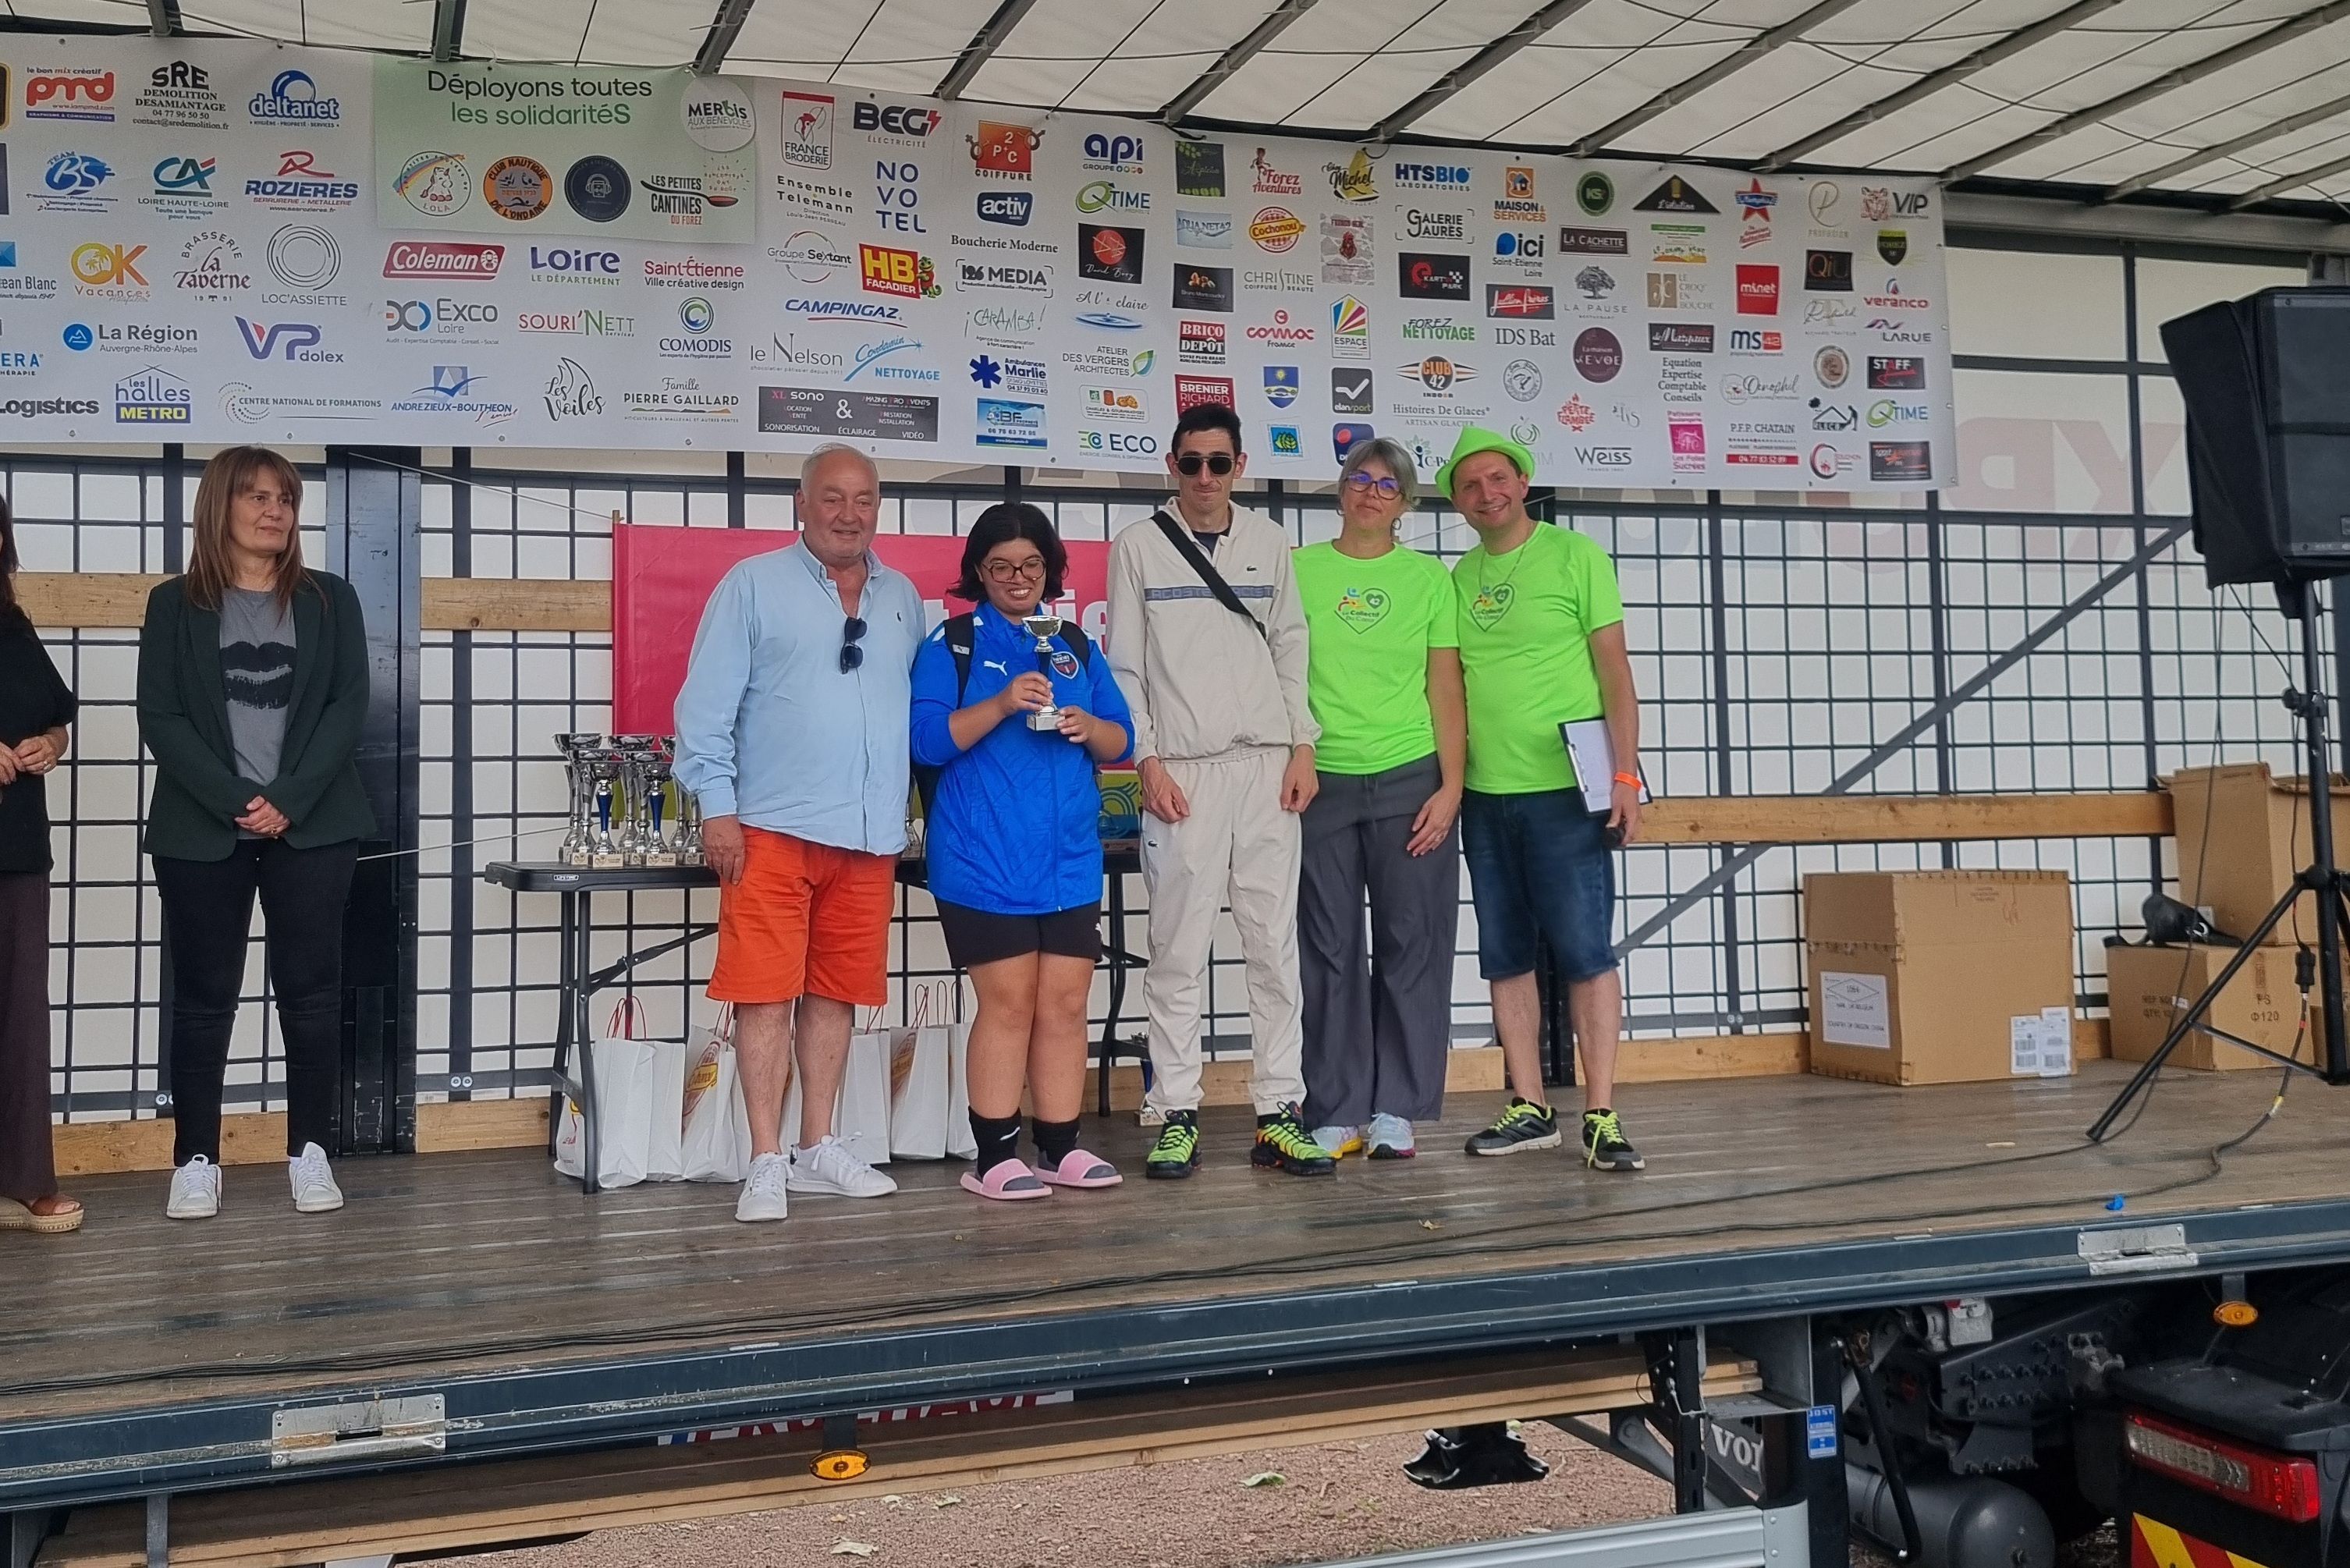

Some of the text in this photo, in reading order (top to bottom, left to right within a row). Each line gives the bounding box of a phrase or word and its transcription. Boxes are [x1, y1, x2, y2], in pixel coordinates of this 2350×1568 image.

[151, 60, 209, 90] SRE
[26, 73, 115, 106] pmd
[428, 70, 652, 102] Déployons toutes
[144, 89, 218, 100] DEMOLITION
[135, 98, 225, 112] DESAMIANTAGE
[249, 93, 339, 120] deltanet
[451, 102, 630, 125] les solidaritéS
[133, 118, 229, 130] contact@sredemolition.fr
[785, 142, 829, 156] FRANCE
[868, 136, 926, 148] ÉLECTRICITÉ
[1084, 133, 1144, 165] api
[785, 152, 829, 166] BRODERIE
[488, 163, 507, 182] CLUB
[508, 158, 548, 182] NAUTIQUE
[876, 161, 919, 183] NO
[974, 169, 1032, 181] COIFFURE
[1083, 164, 1115, 172] GROUPE
[1396, 164, 1471, 183] HTSBIO
[651, 175, 666, 186] LES
[668, 176, 701, 190] PETITES
[1266, 169, 1300, 186] Forez
[245, 179, 358, 199] ROZIERES
[777, 175, 854, 199] Ensemble
[1252, 182, 1301, 195] Aventures
[1396, 183, 1470, 192] LABORATORIES
[138, 197, 229, 208] LOIRE HAUTE-LOIRE
[651, 193, 702, 215] CANTINES
[777, 190, 854, 215] Telemann
[877, 186, 918, 208] VO
[1893, 192, 1928, 214] VIP
[982, 197, 1028, 218] activ
[1494, 200, 1538, 211] MAISON
[671, 215, 702, 225] DU FOREZ
[876, 211, 926, 233] TEL
[1493, 211, 1546, 222] SERVICES
[1251, 222, 1297, 237] Cochonou
[182, 232, 243, 258] BRASSERIE
[951, 234, 1058, 254] Boucherie Moderne
[1517, 234, 1544, 257] ici
[1564, 233, 1625, 247] LA CACHETTE
[392, 247, 479, 270] Coleman
[531, 247, 620, 273] Loire
[768, 247, 804, 261] Groupe
[808, 249, 851, 264] Sextant
[71, 243, 149, 286] OK
[864, 248, 914, 283] HB
[173, 269, 250, 291] Taverne
[546, 274, 620, 286] DÉPARTEMENT
[988, 268, 1047, 286] MEDIA
[1525, 268, 1542, 278] Loire
[25, 276, 57, 291] Blanc
[645, 278, 744, 290] Ville créative design
[866, 278, 916, 294] FAÇADIER
[75, 285, 151, 299] Vacances
[262, 293, 347, 306] LOC'ASSIETTE
[1863, 296, 1929, 308] veranco
[785, 299, 899, 319] CAMPINGAZ
[1587, 304, 1628, 313] PAUSE
[438, 323, 465, 334] Loire
[1182, 323, 1224, 338] BRICO
[1408, 318, 1452, 329] FOREZ
[99, 325, 197, 344] La Région
[1403, 325, 1475, 341] NETTOYAGE
[1496, 328, 1556, 346] IDS Bat
[1882, 332, 1931, 342] LARUE
[100, 343, 197, 354] Auvergne-Rhône-Alpes
[659, 339, 731, 353] COMODIS
[1334, 337, 1367, 346] ESPACE
[300, 349, 344, 363] dolex
[751, 332, 843, 366] le Nelson
[1097, 346, 1127, 355] ATELIER
[1063, 353, 1130, 367] DES VERGERS
[1663, 357, 1702, 368] Equation
[1873, 358, 1910, 369] STAFF
[875, 367, 940, 381] NETTOYAGE
[1005, 364, 1046, 379] Marlie
[1074, 364, 1130, 377] ARCHITECTES
[1422, 361, 1451, 376] CLUB
[1663, 369, 1702, 380] Expertise
[130, 378, 145, 388] les
[662, 377, 701, 392] Famille
[1429, 374, 1445, 389] 42
[1658, 380, 1707, 391] Comptable
[115, 377, 190, 402] halles
[1180, 383, 1229, 396] BRENIER
[239, 396, 270, 406] CENTRE
[272, 398, 314, 406] NATIONAL
[330, 399, 382, 407] FORMATIONS
[624, 393, 740, 406] PIERRE GAILLARD
[1180, 393, 1230, 404] RICHARD
[1663, 392, 1702, 402] Conseils
[120, 406, 186, 420] METRO
[392, 403, 513, 413] ANDREZIEUX-BOUTHEON
[1393, 403, 1452, 415] Histoires De
[765, 422, 877, 437] SONORISATION ÉCLAIRAGE
[1755, 424, 1794, 434] CHATAIN
[1109, 435, 1157, 453] ECO
